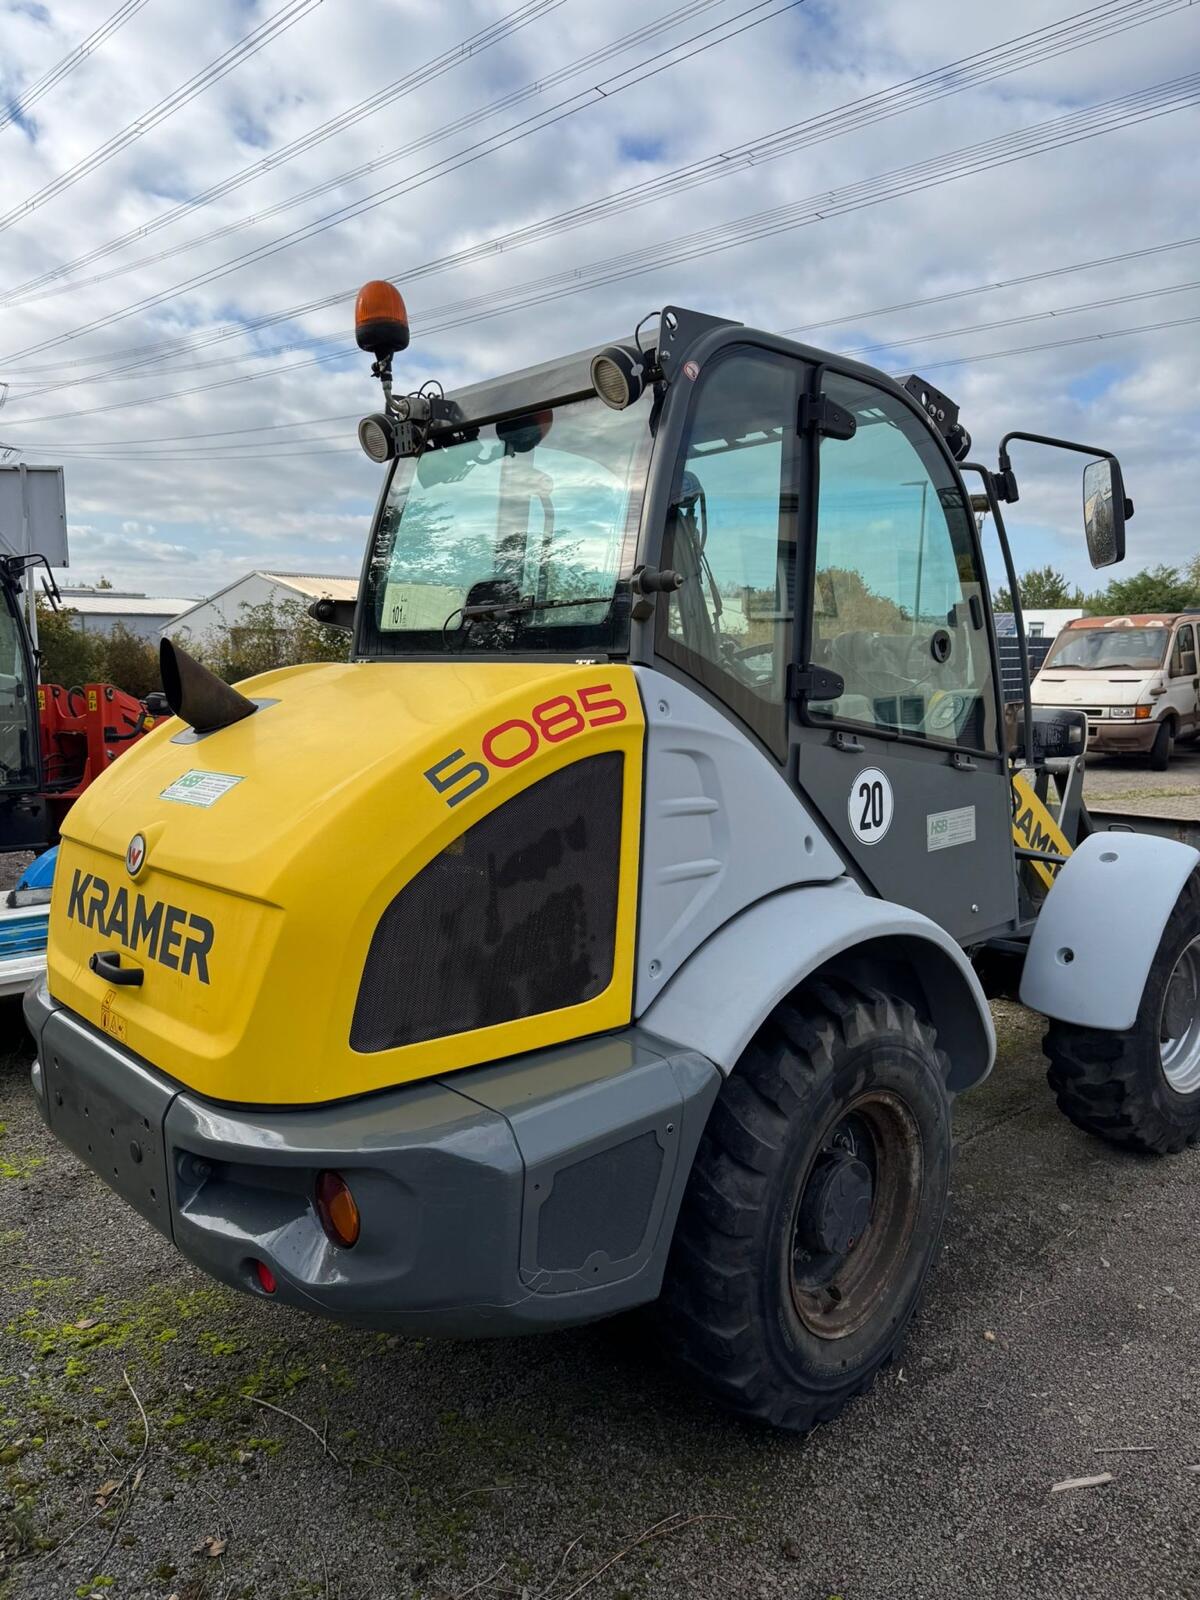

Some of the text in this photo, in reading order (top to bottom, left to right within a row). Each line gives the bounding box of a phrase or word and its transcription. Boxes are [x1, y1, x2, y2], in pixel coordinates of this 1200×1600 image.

[423, 683, 627, 808] 5085
[859, 780, 884, 831] 20
[930, 819, 949, 836] HSB
[67, 868, 215, 985] KRAMER
